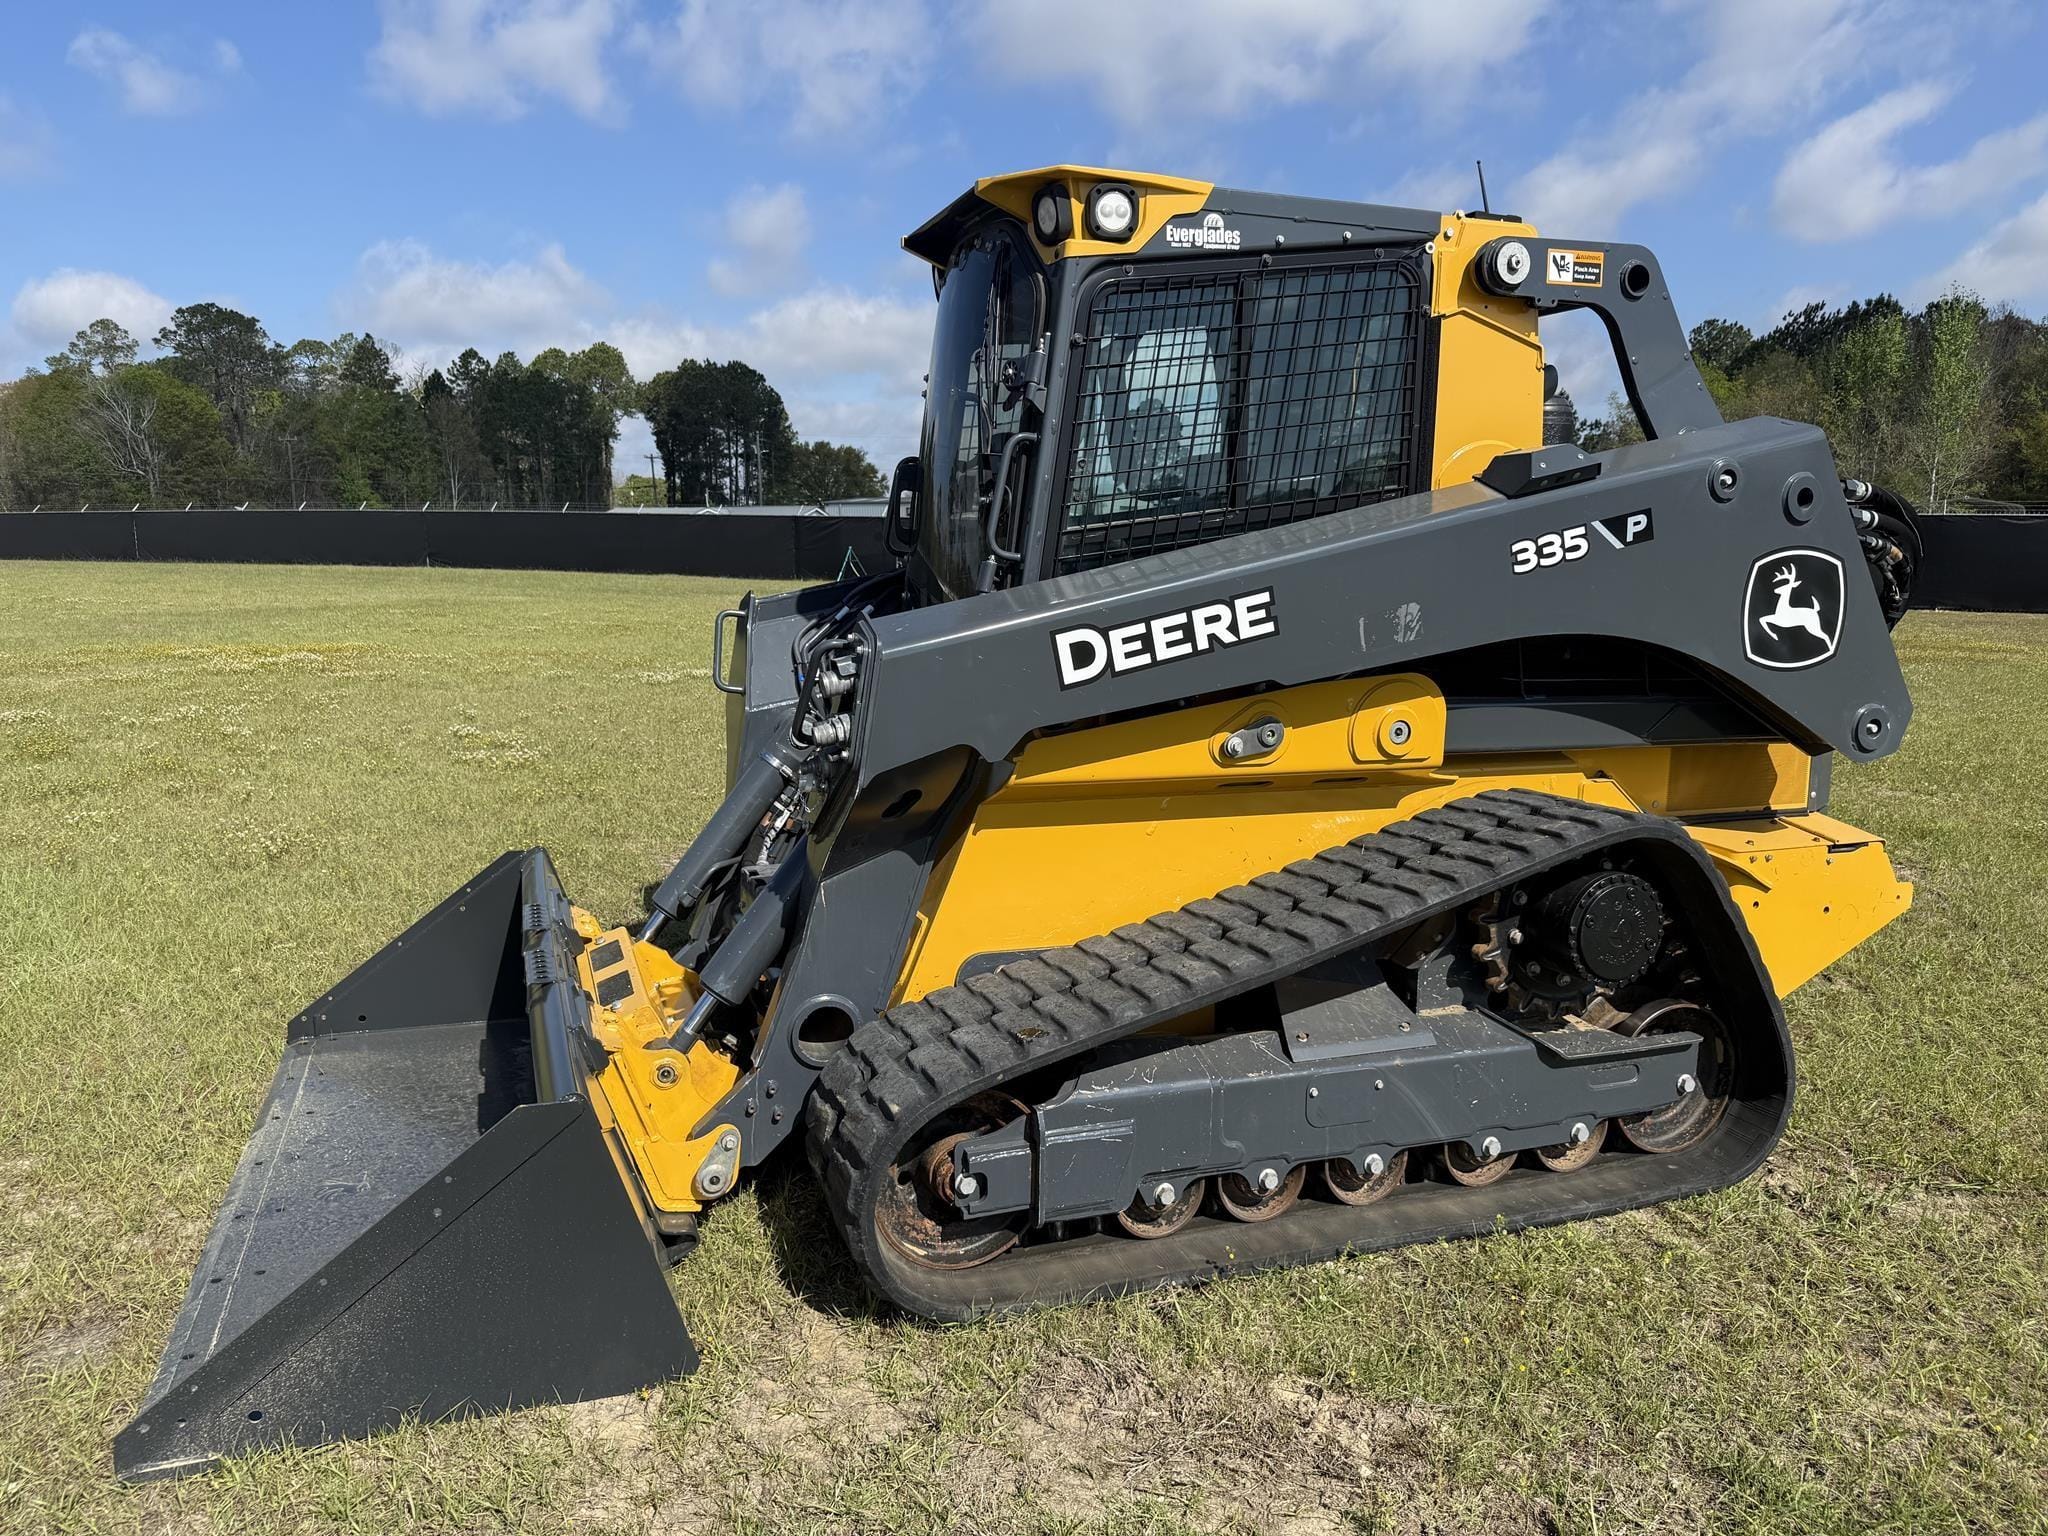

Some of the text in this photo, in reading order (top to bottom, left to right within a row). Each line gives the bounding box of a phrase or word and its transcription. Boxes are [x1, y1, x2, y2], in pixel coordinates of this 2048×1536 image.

[1166, 224, 1241, 247] Everglades
[1511, 526, 1589, 573] 335
[1054, 591, 1276, 685] DEERE
